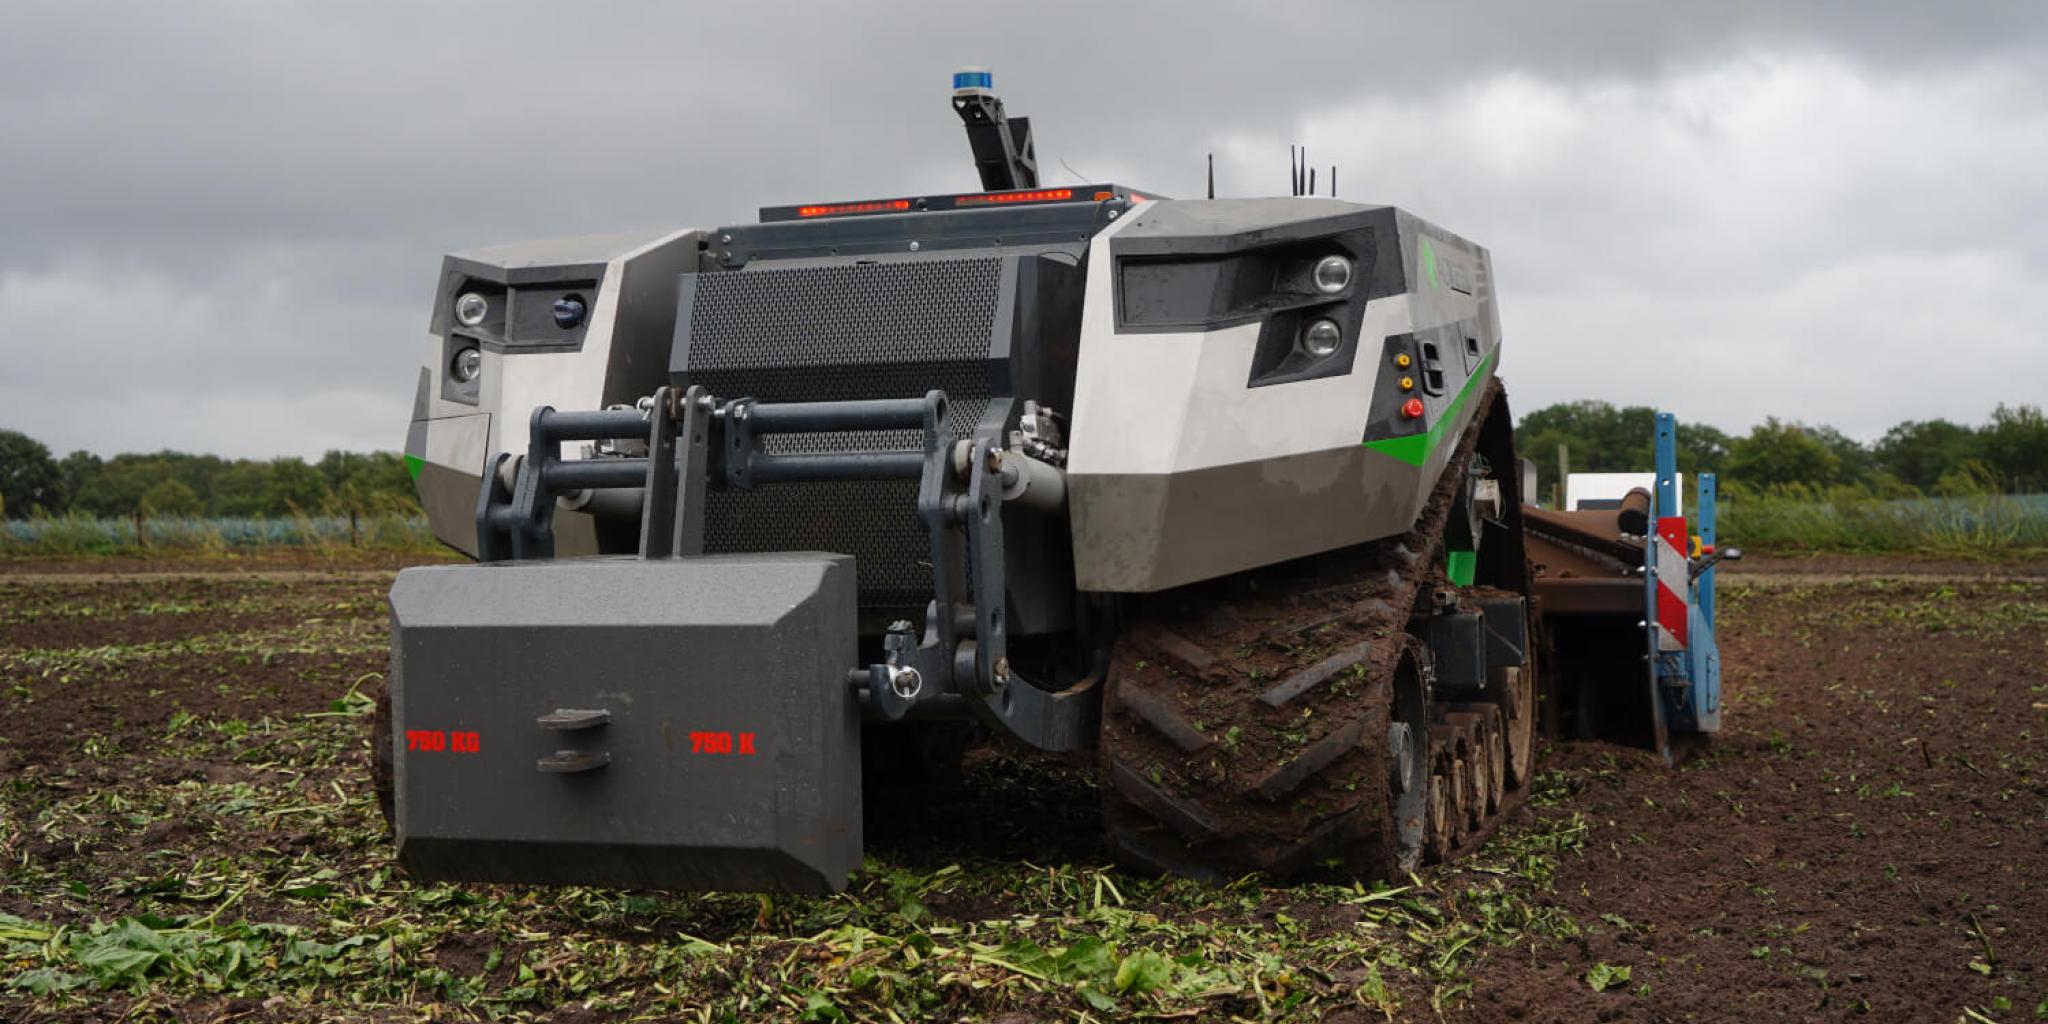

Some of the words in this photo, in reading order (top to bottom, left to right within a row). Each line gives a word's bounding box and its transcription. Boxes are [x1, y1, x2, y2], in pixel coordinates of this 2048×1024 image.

[405, 729, 446, 753] 750
[450, 730, 481, 753] KG
[688, 730, 733, 754] 750
[738, 731, 757, 756] K
